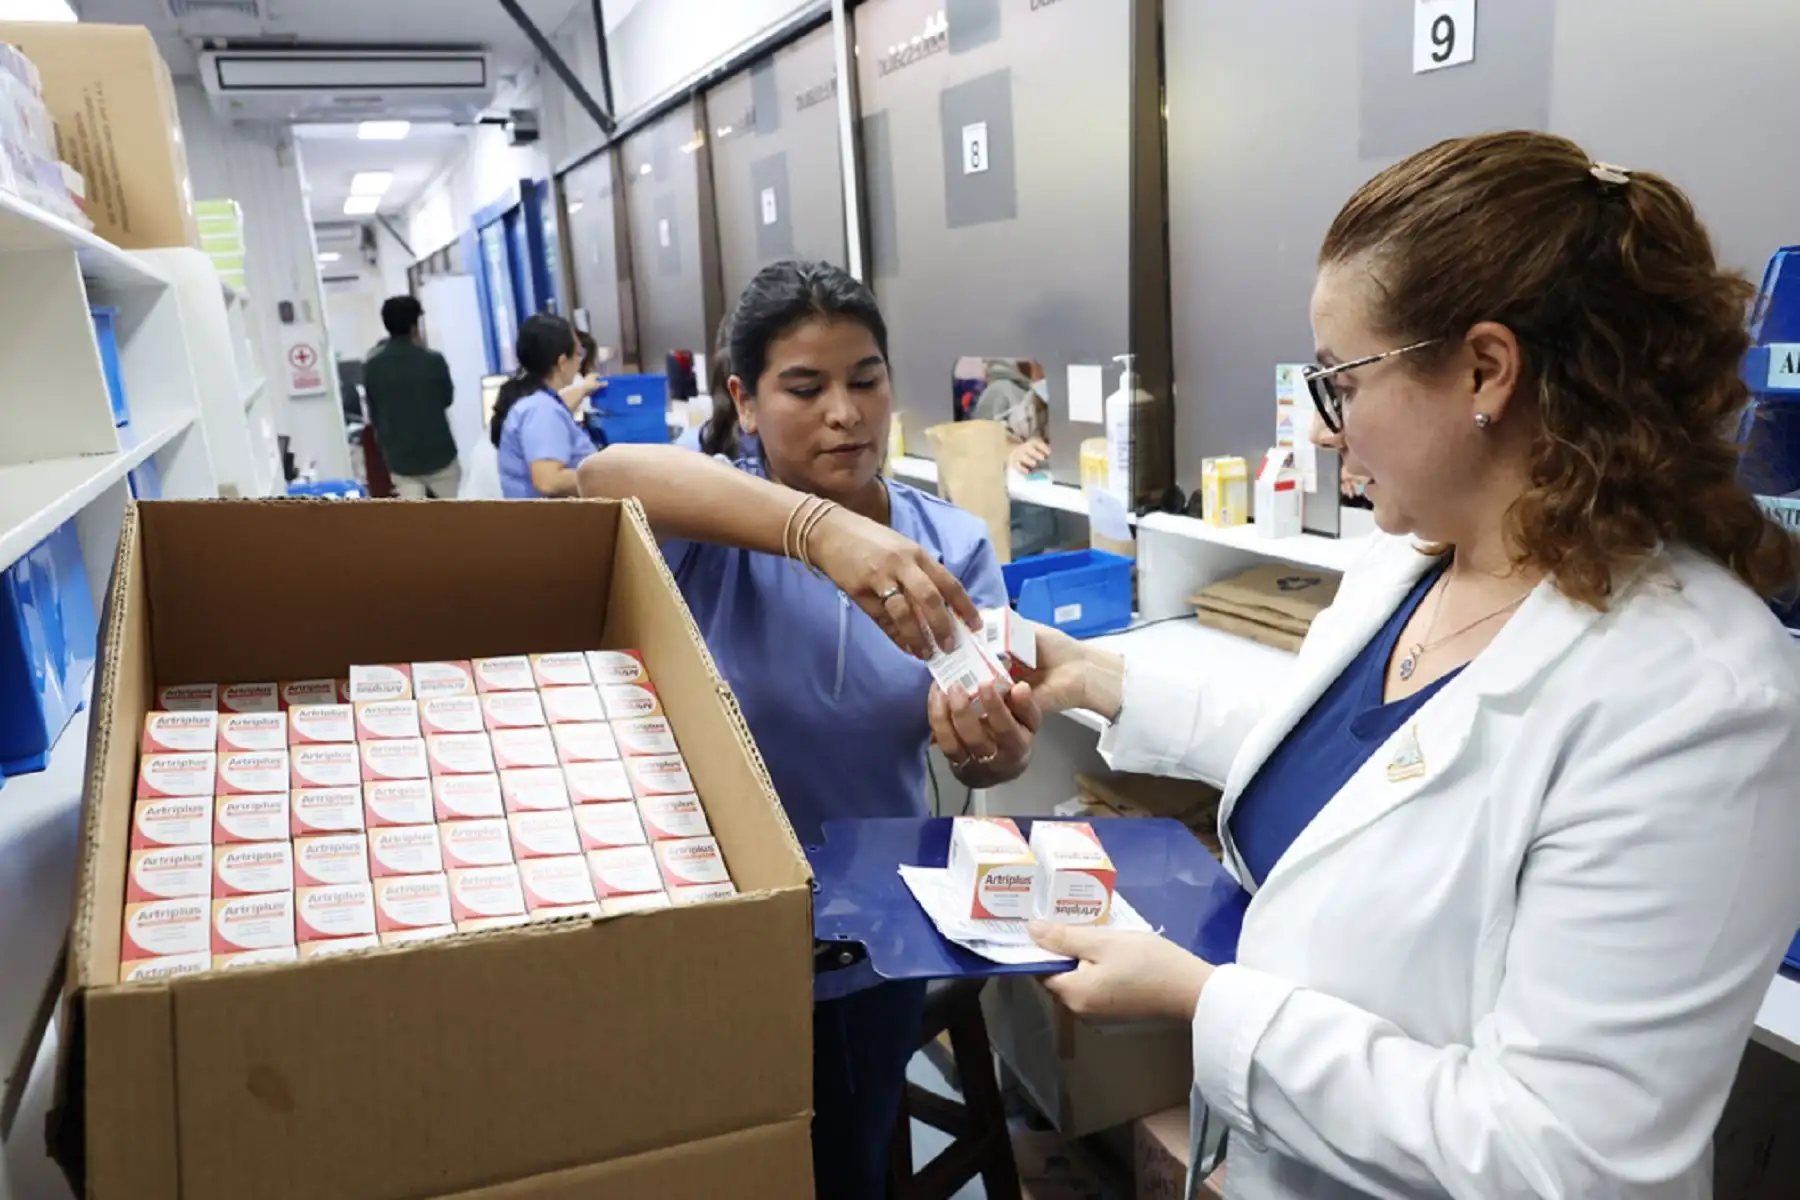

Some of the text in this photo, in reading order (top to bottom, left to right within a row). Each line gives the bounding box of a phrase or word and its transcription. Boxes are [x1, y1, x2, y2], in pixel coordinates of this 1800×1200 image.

[1431, 14, 1455, 63] 9
[971, 140, 980, 169] 8
[298, 709, 349, 720] Artriplus
[156, 715, 212, 728] Artriplus
[228, 718, 281, 730] Artriplus
[228, 757, 282, 769] Artriplus
[300, 750, 352, 763] Artriplus
[151, 759, 208, 771] Artriplus
[301, 795, 355, 806] Artriplus
[146, 804, 205, 817] Artriplus
[227, 801, 282, 814] Artriplus
[306, 841, 361, 855] Artriplus
[142, 853, 204, 868] Artriplus
[226, 850, 284, 864] Artriplus
[984, 874, 1033, 888] Artriplus
[308, 889, 366, 906] Artriplus
[137, 905, 203, 923] Artriplus
[224, 902, 287, 919] Artriplus
[1054, 904, 1103, 917] Artriplus
